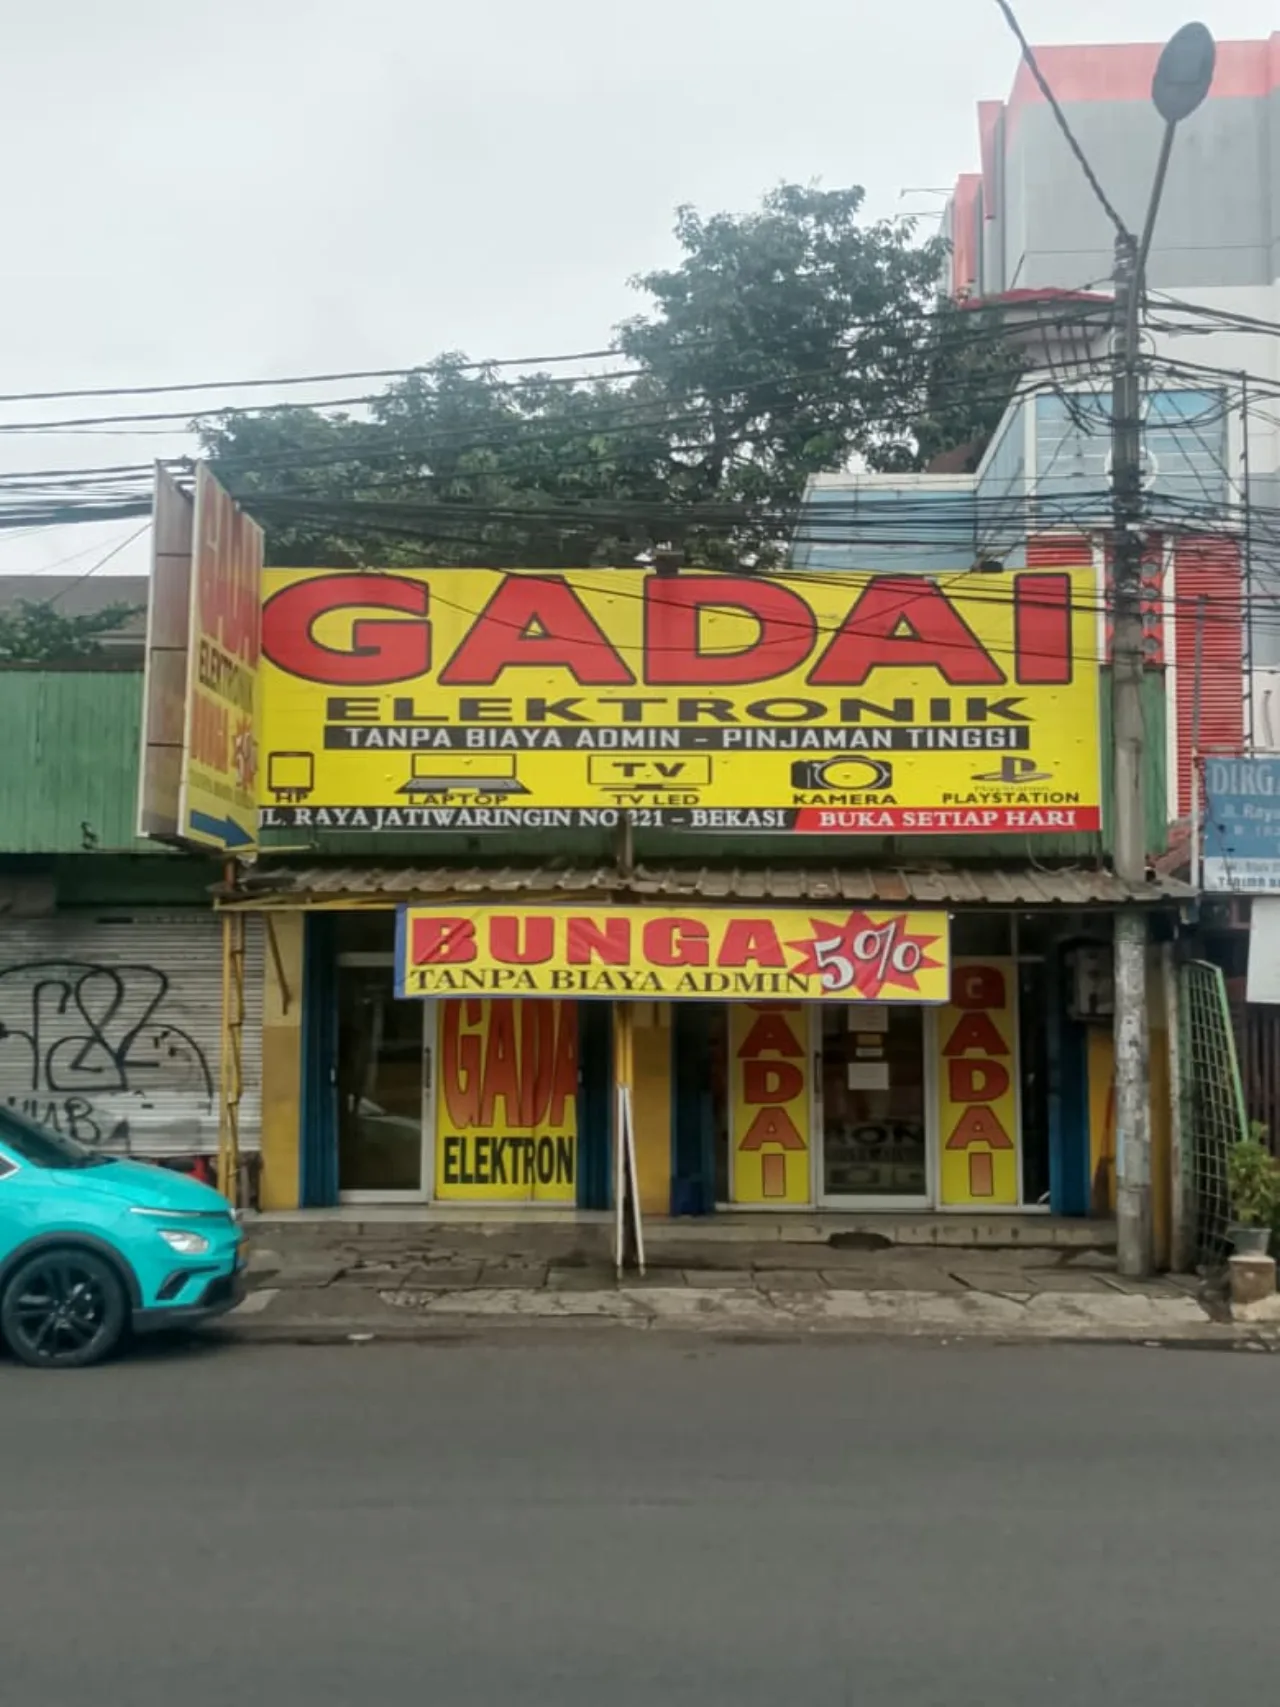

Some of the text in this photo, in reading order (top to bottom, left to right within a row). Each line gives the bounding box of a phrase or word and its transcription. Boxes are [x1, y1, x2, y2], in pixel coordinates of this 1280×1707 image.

[262, 572, 1073, 686] GADAI
[327, 697, 1036, 722] ELEKTRONIK
[346, 728, 450, 748] TANPA
[466, 728, 562, 748] BIAYA
[575, 728, 681, 748] ADMIN
[723, 728, 893, 748] PINJAMAN
[907, 728, 1017, 748] TINGGI
[612, 762, 686, 777] TV
[1213, 763, 1280, 795] DIRG
[275, 790, 308, 803] HP
[408, 793, 508, 806] LAPTOP
[612, 794, 700, 806] TV LED
[793, 793, 898, 806] KAMERA
[942, 792, 1080, 804] PLAYSTATION
[294, 808, 370, 826] RAYA
[371, 808, 572, 830] JATIWARINGIN
[579, 809, 619, 826] NO
[690, 809, 787, 828] BEKASI
[818, 810, 1077, 828] BUKA SETIAP HARI
[412, 915, 921, 991] BUNGA 5%
[409, 968, 810, 993] TANPA BIAYA ADMIN
[941, 965, 1014, 1198] GADAI
[736, 1002, 807, 1198] ADAI
[443, 1136, 575, 1185] ELEKTRON
